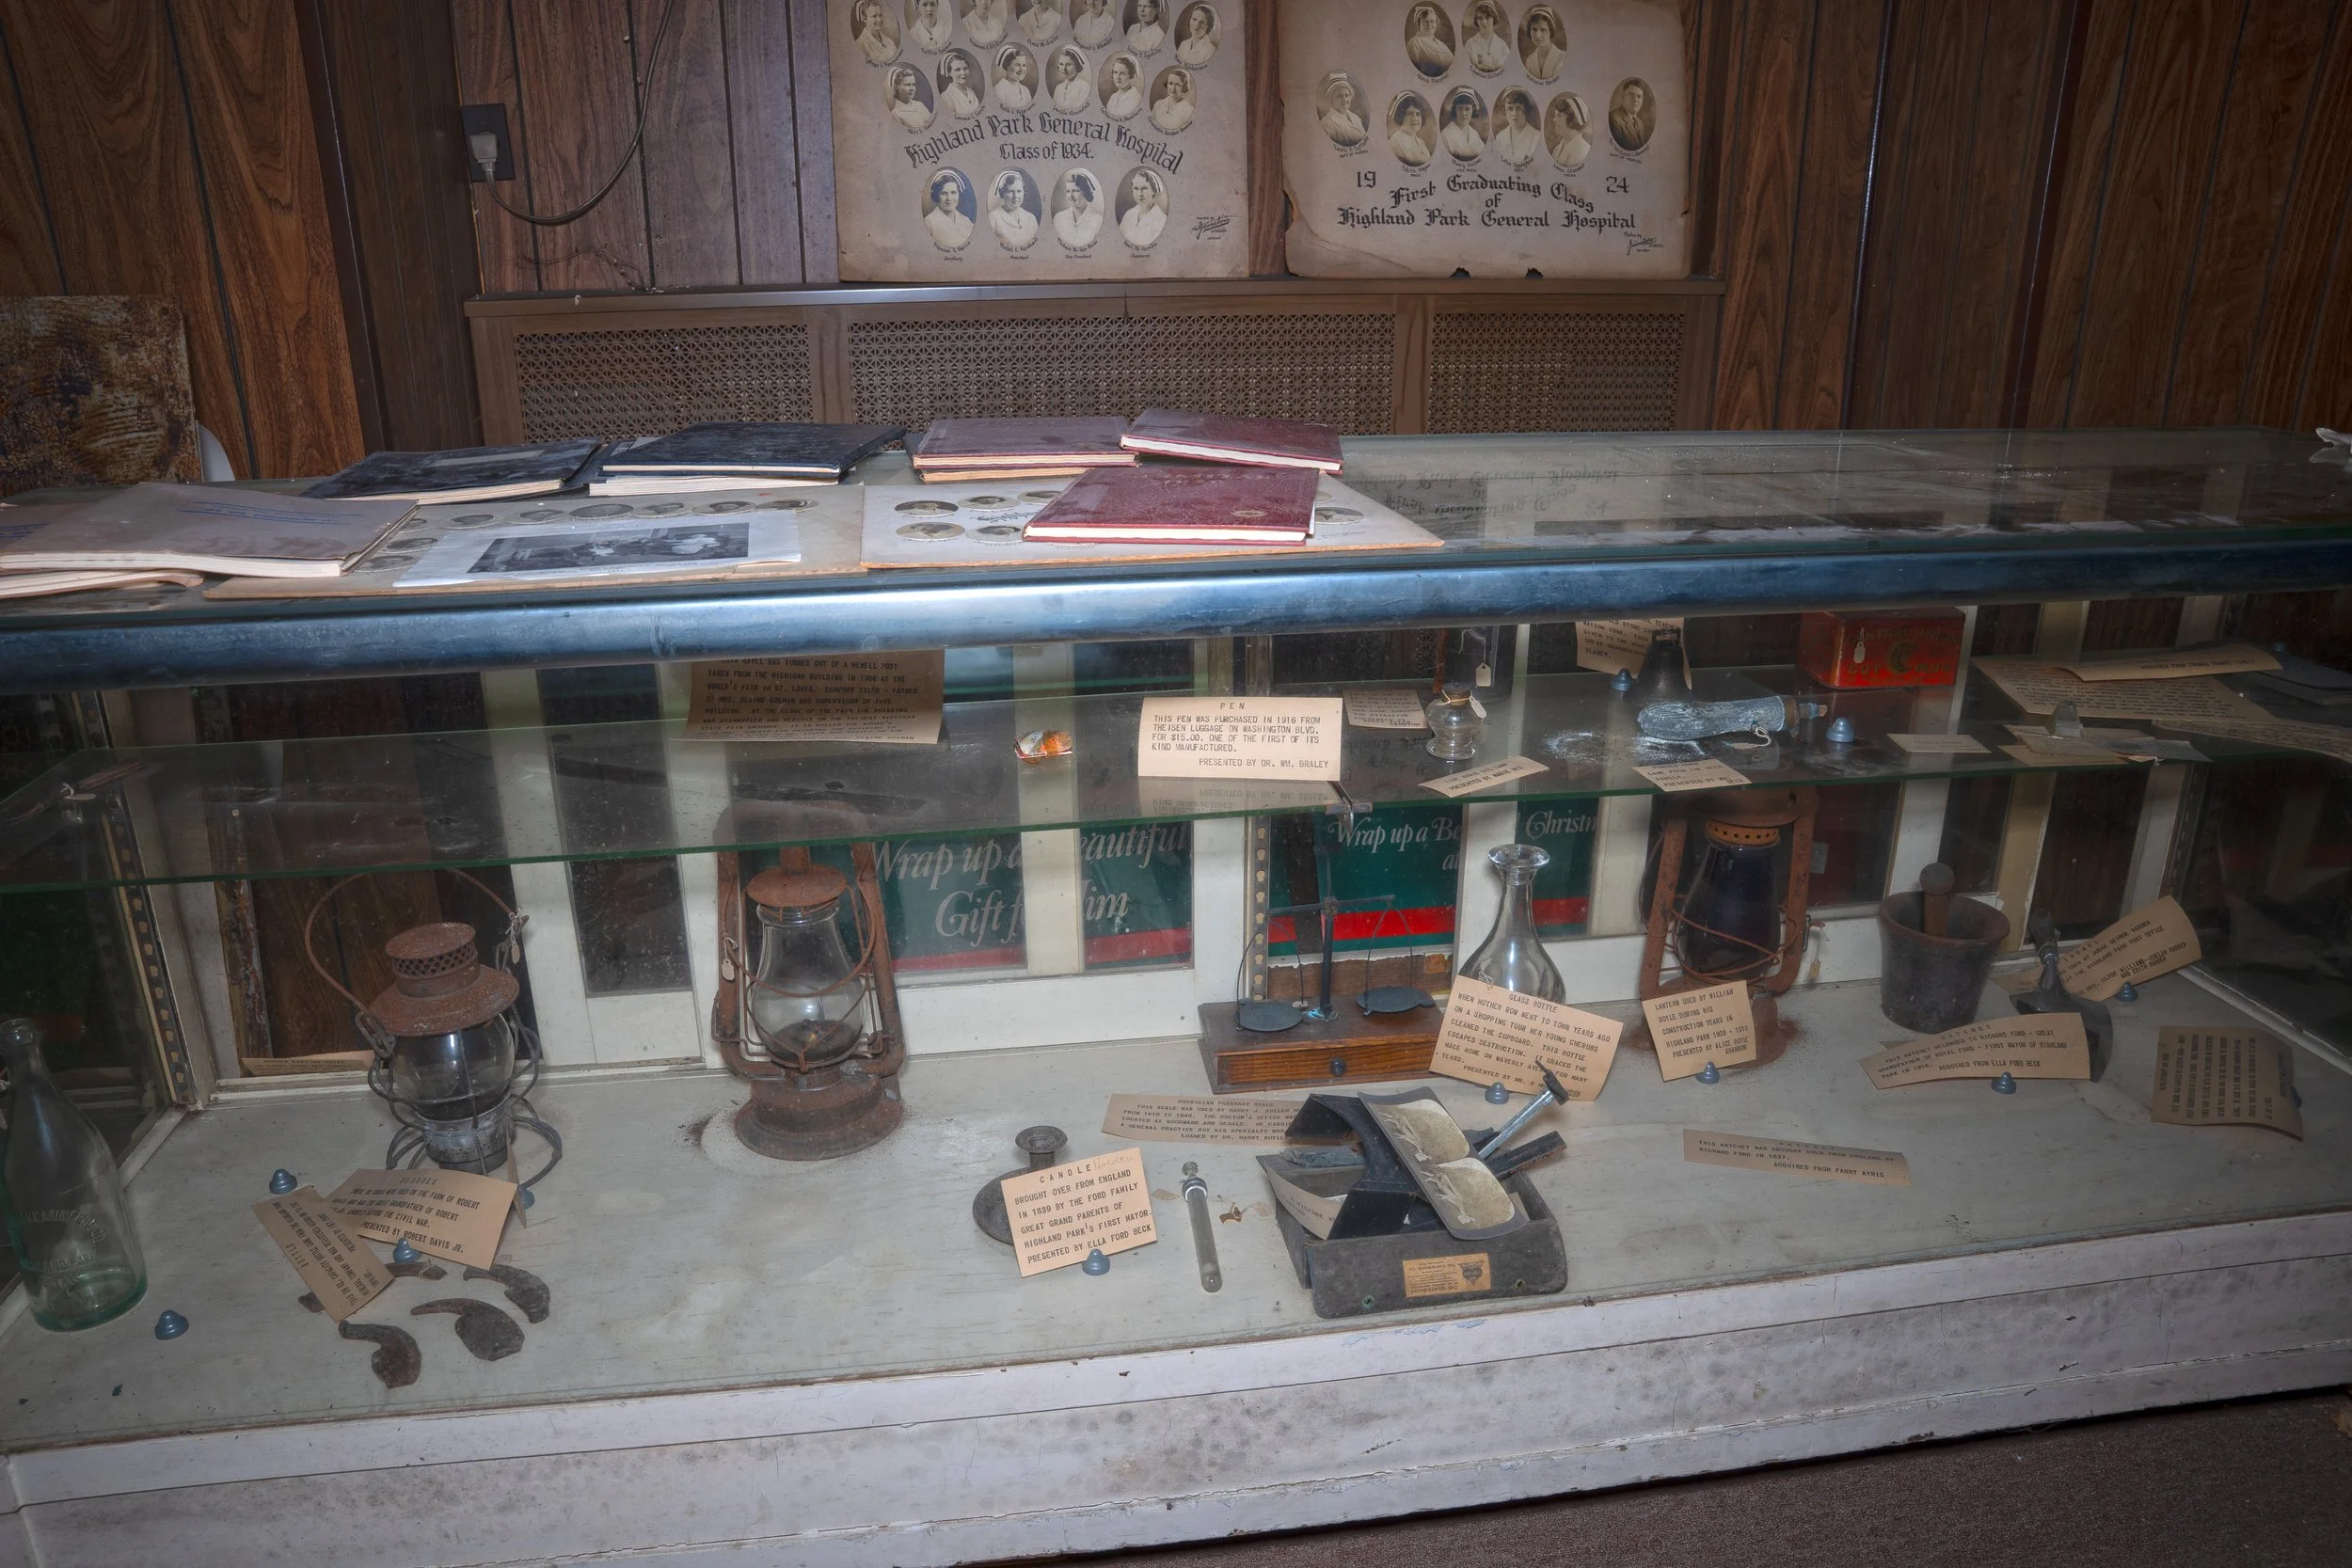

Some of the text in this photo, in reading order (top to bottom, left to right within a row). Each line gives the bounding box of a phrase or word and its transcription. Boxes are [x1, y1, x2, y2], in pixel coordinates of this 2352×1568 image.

[904, 119, 985, 168] Highland
[988, 115, 1034, 137] Park
[1039, 111, 1110, 141] General
[1115, 125, 1184, 175] Hospital
[999, 142, 1094, 159] Class of 1934.
[1356, 171, 1376, 188] 19
[1389, 174, 1595, 213] First Graduating Class
[1606, 176, 1630, 194] 24
[1486, 193, 1502, 208] of
[1337, 207, 1636, 234] Highland Park General Hospital
[1327, 816, 1385, 853] Wrap
[1391, 822, 1413, 851] up
[1416, 826, 1427, 842] a
[962, 838, 1002, 886] up
[935, 890, 1001, 947] Gift
[1458, 992, 1474, 1003] WHEN
[1478, 998, 1502, 1010] MOTHER
[1521, 1011, 1537, 1022] WENT
[1541, 1017, 1550, 1025] TO
[1553, 1021, 1569, 1031] TOWN
[1573, 1026, 1594, 1038] YEARS
[1597, 1033, 1611, 1042] AGO
[1509, 993, 1558, 1013] GLASS BOTTLE
[1451, 1019, 1585, 1062] CLEANED THE CUPBOARD. THIS BOTTLE
[1454, 1006, 1463, 1014] ON
[1473, 1011, 1506, 1026] SHOPPING
[1510, 1022, 1527, 1032] TOUR
[1530, 1028, 1542, 1037] HER
[1546, 1033, 1566, 1045] YOUNG
[1569, 1039, 1598, 1053] CHERUBS
[1662, 1022, 1704, 1035] CONSTRUCTION
[1707, 1017, 1724, 1025] YEARS
[1442, 1053, 1465, 1064] YEARS.
[1447, 1031, 1476, 1044] ESCAPED
[1479, 1039, 1526, 1057] DESTRUCTION.
[1547, 1058, 1571, 1069] GRACED
[1575, 1065, 1587, 1073] THE
[1464, 1048, 1480, 1056] HOME
[1496, 1055, 1524, 1068] WAVERLY
[1555, 1070, 1568, 1079] FOR
[1571, 1075, 1587, 1084] MANY
[430, 1192, 480, 1210] FARM OF ROBERT
[1014, 1169, 1131, 1205] BROUGHT OVER FROM ENGLAND
[1018, 1182, 1138, 1219] IN 1839 BY THE FORD FAMILY
[361, 1222, 463, 1253] PRESENTED BY ROBERT DAVIS JR.
[396, 1212, 413, 1223] CIVIL
[416, 1218, 430, 1227] WAR.
[1021, 1223, 1044, 1234] GREAT
[1049, 1216, 1073, 1227] GRAND
[1077, 1206, 1109, 1221] PARENTS
[1025, 1210, 1152, 1248] HIGHLAND PARK'S FIRST MAYOR.
[1027, 1224, 1152, 1264] PRESENTED BY ELLA FORD BECK
